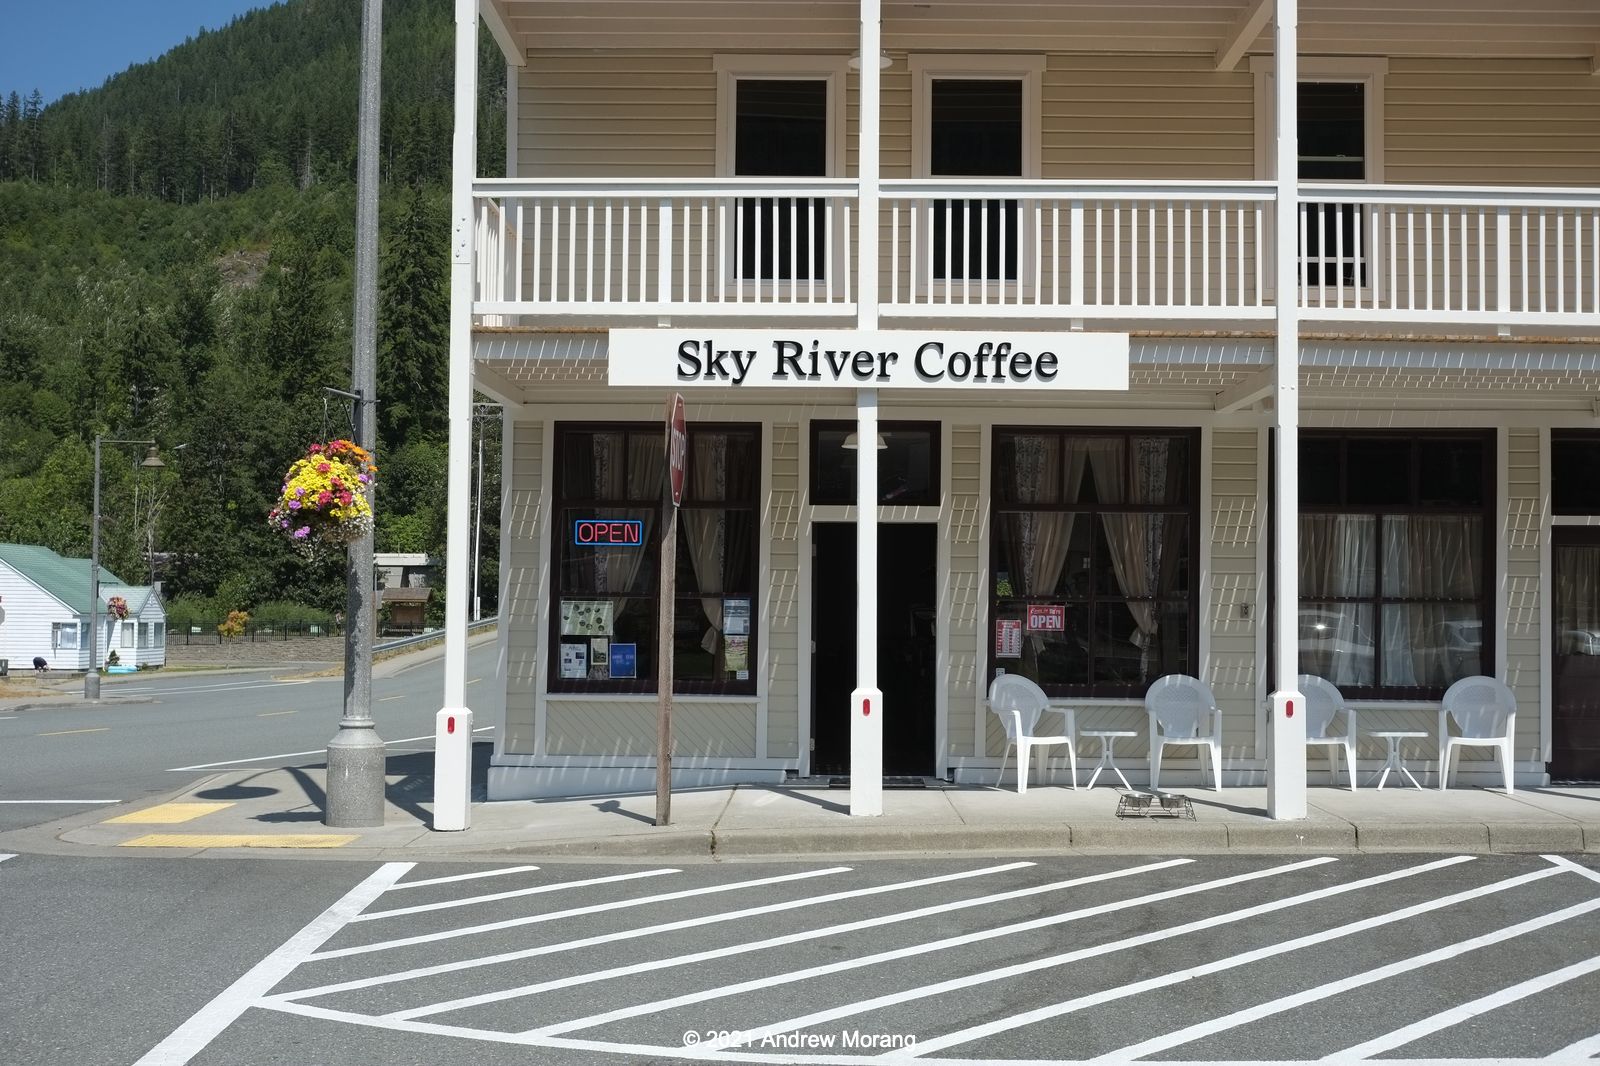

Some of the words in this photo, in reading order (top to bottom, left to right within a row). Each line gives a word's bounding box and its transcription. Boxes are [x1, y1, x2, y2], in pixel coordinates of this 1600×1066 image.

[677, 339, 758, 385] Sky
[772, 339, 899, 379] River
[914, 341, 1059, 381] Coffee
[672, 426, 686, 472] STOP
[578, 522, 639, 543] OPEN
[1031, 615, 1061, 628] OPEN
